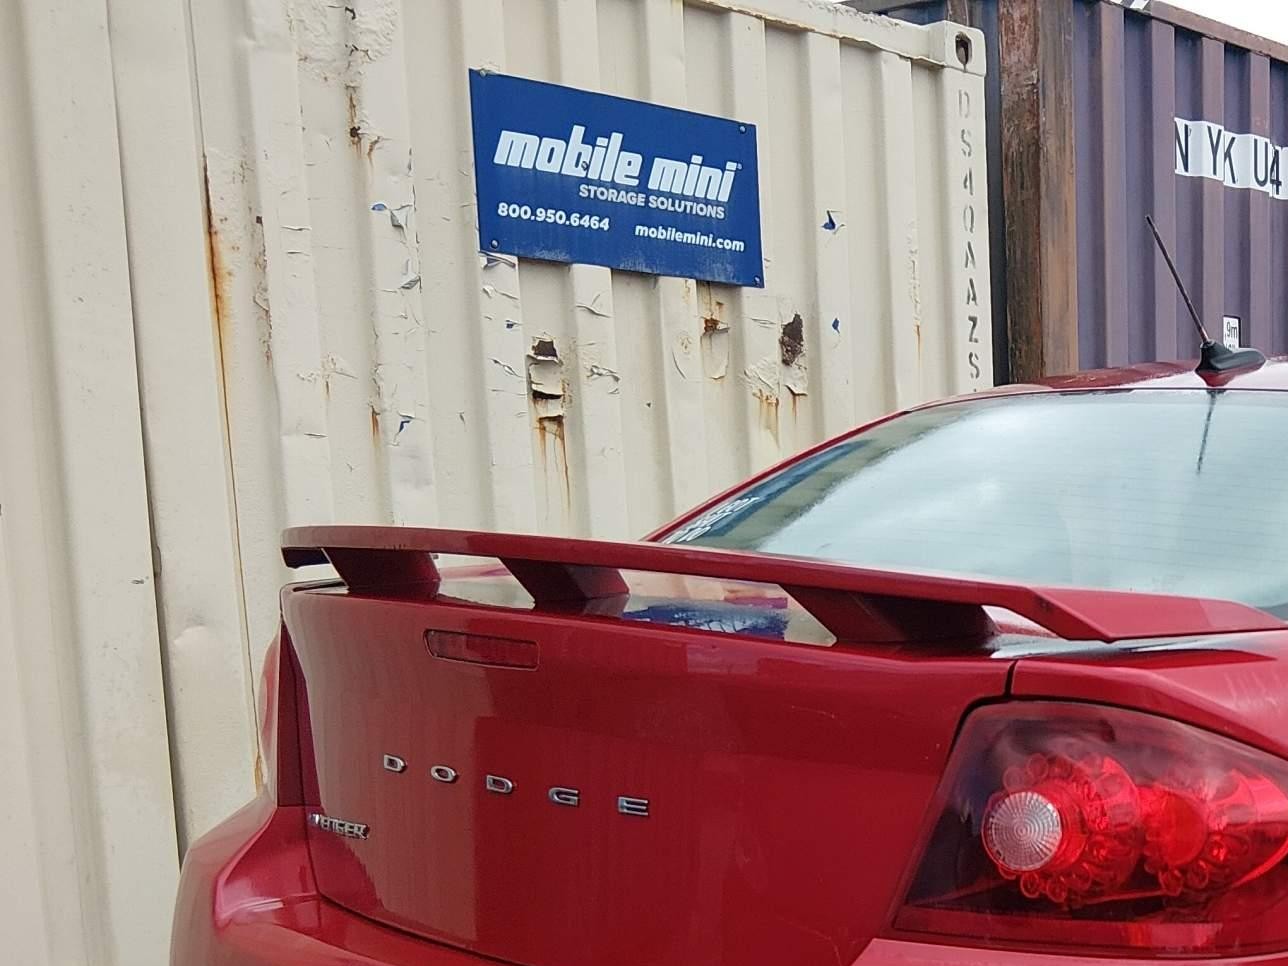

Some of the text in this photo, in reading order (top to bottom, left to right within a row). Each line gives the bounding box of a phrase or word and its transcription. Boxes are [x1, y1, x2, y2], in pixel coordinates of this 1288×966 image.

[493, 125, 738, 202] mobile mini
[497, 202, 745, 252] 800.950.6464 mobilemini.com
[579, 183, 725, 220] STORAGE SOLUTIONS
[383, 754, 650, 816] DODGE
